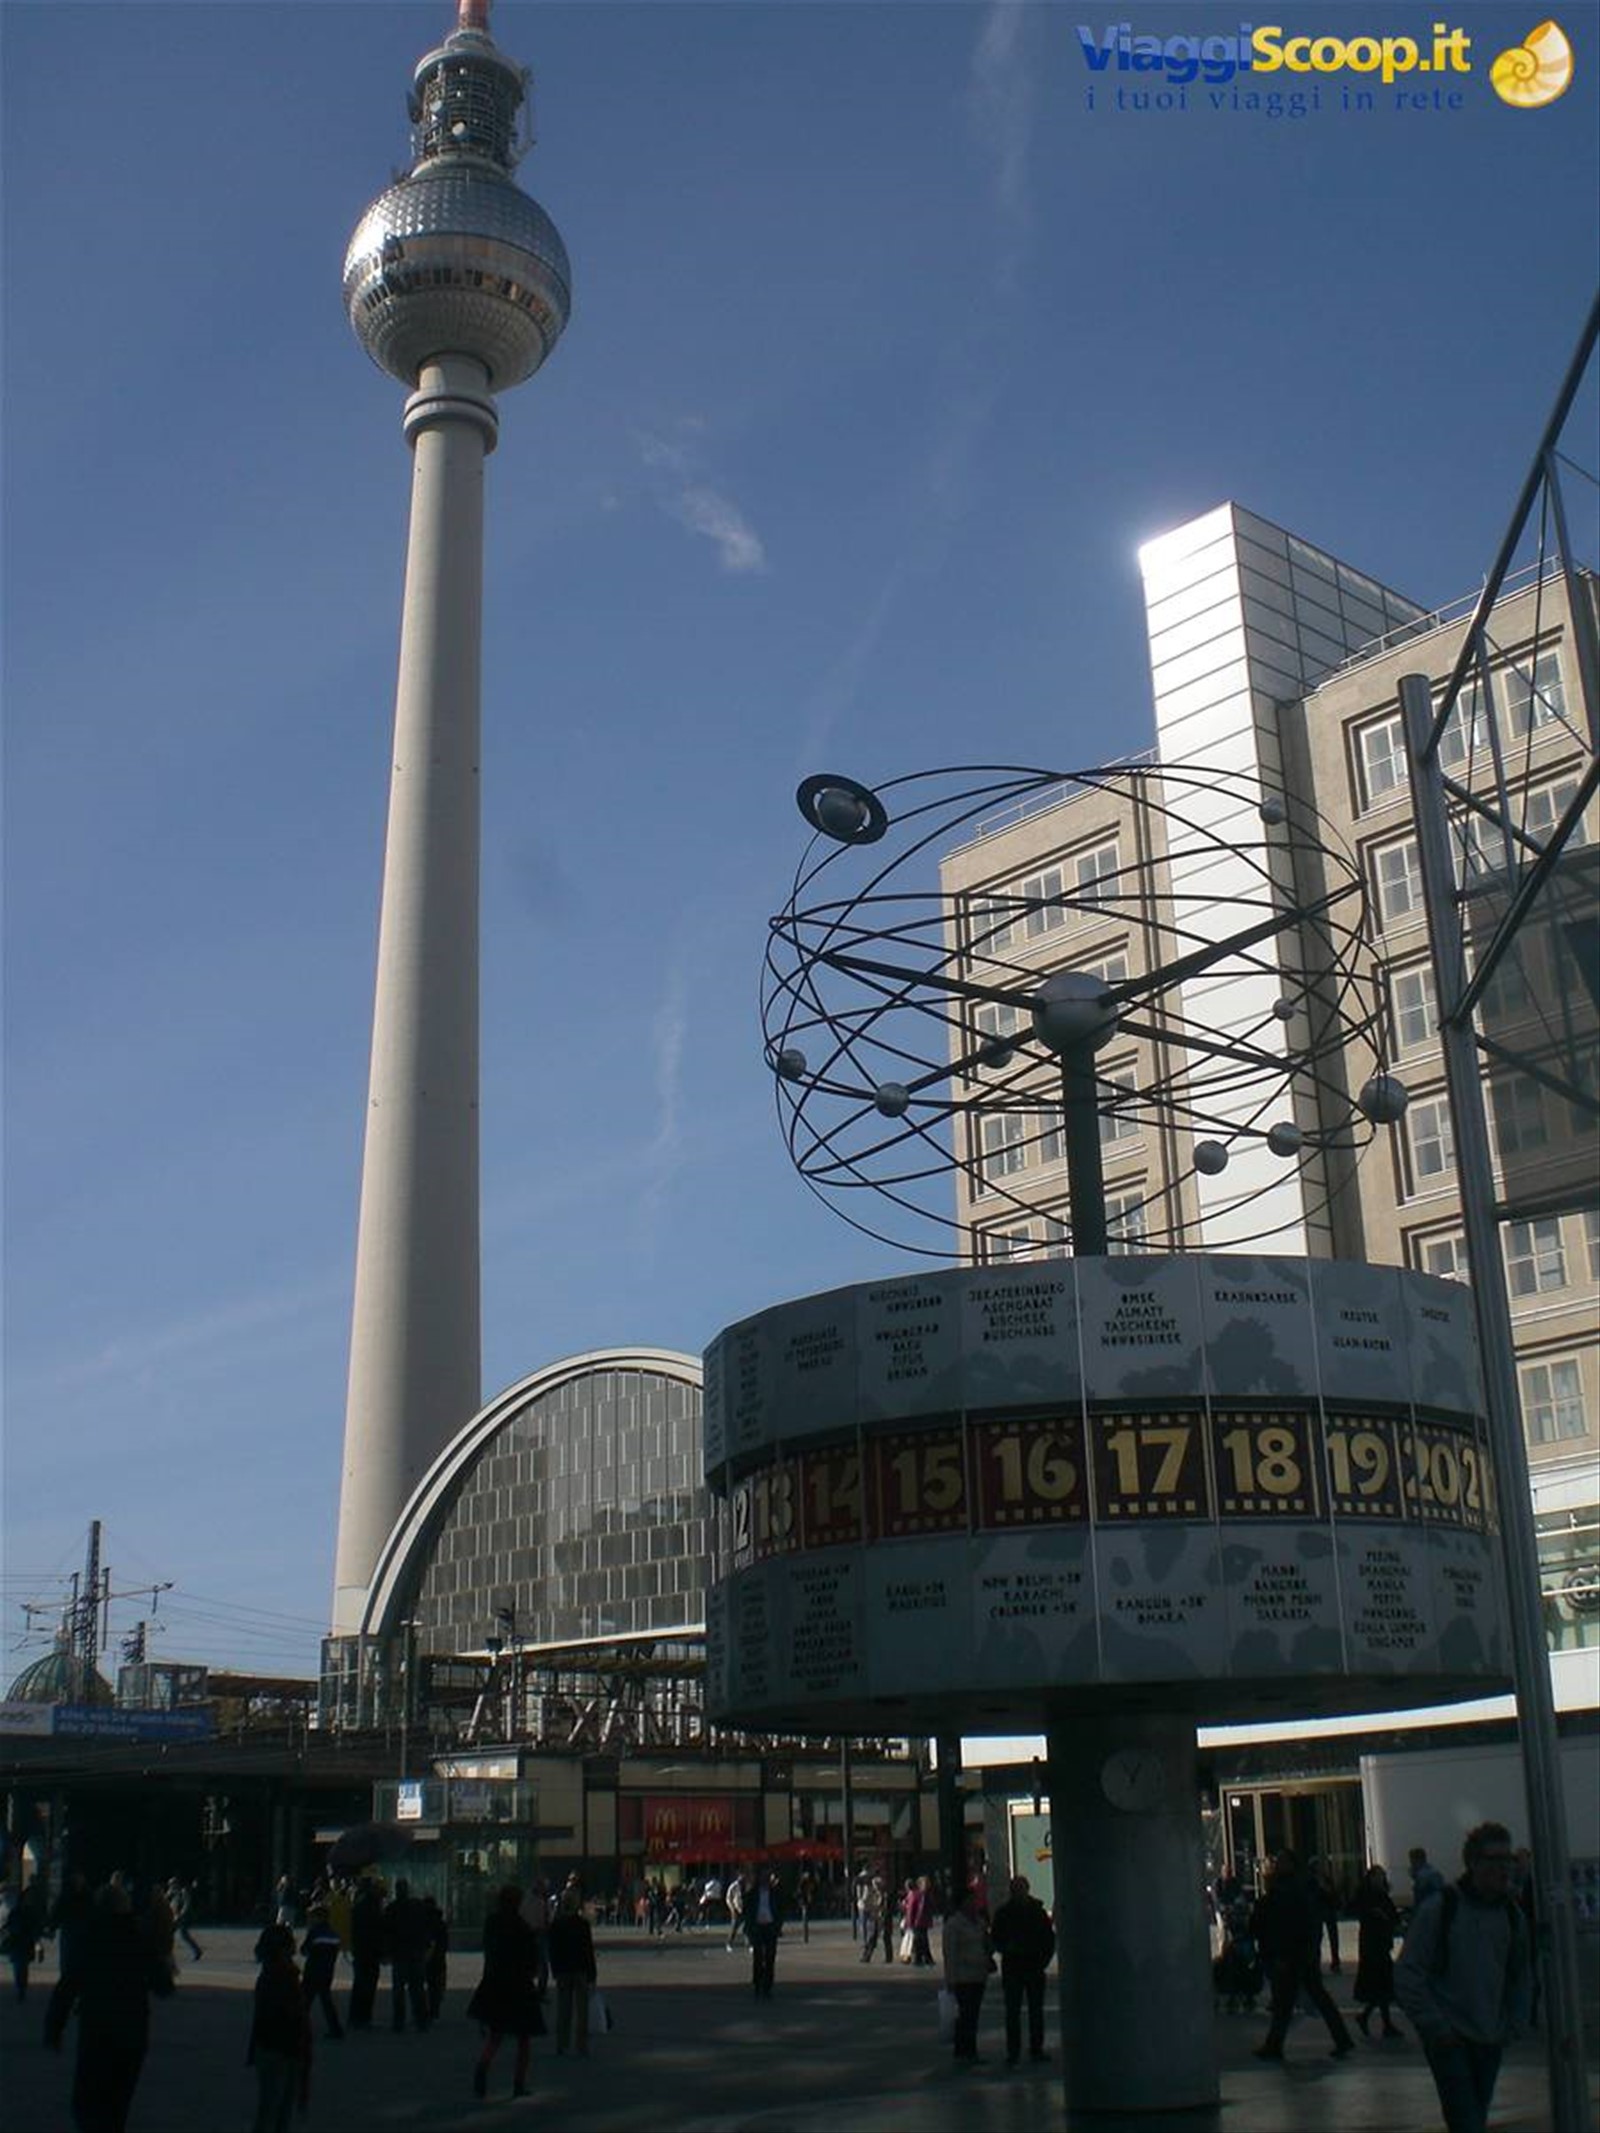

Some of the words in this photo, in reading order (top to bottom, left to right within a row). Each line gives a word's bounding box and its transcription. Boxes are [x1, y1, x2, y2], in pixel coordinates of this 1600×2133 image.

[809, 1456, 862, 1526] 14
[893, 1443, 963, 1513] 15
[992, 1430, 1077, 1501] 16
[1106, 1427, 1191, 1494] 17
[1222, 1427, 1302, 1495] 18
[1326, 1430, 1389, 1496] 19
[1403, 1436, 1459, 1505] 20
[755, 1473, 792, 1541] 13
